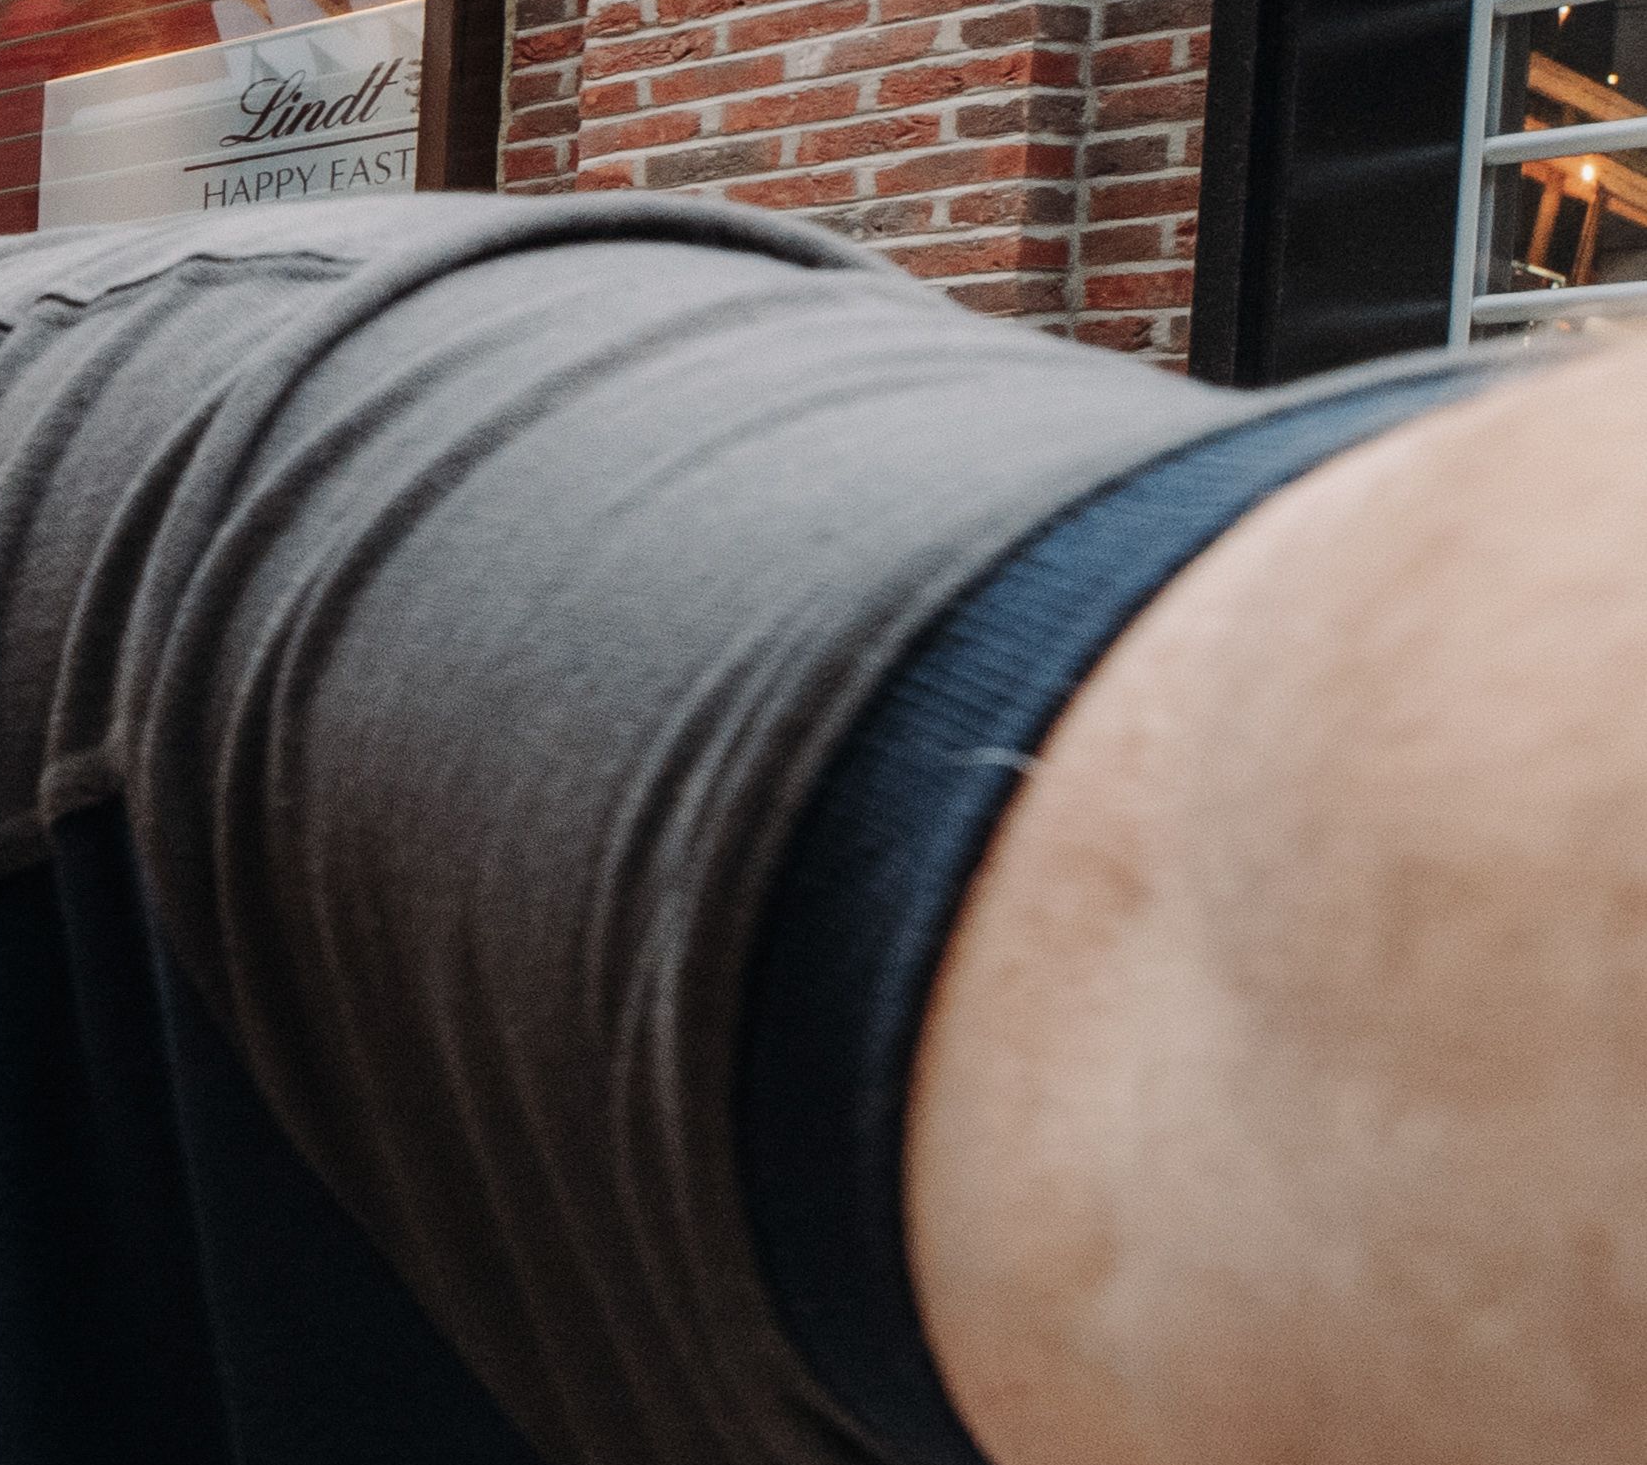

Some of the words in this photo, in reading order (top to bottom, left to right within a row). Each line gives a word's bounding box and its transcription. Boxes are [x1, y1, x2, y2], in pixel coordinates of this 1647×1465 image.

[219, 57, 404, 147] Lindt
[204, 165, 316, 211] HAPPY
[330, 148, 416, 192] EAST
